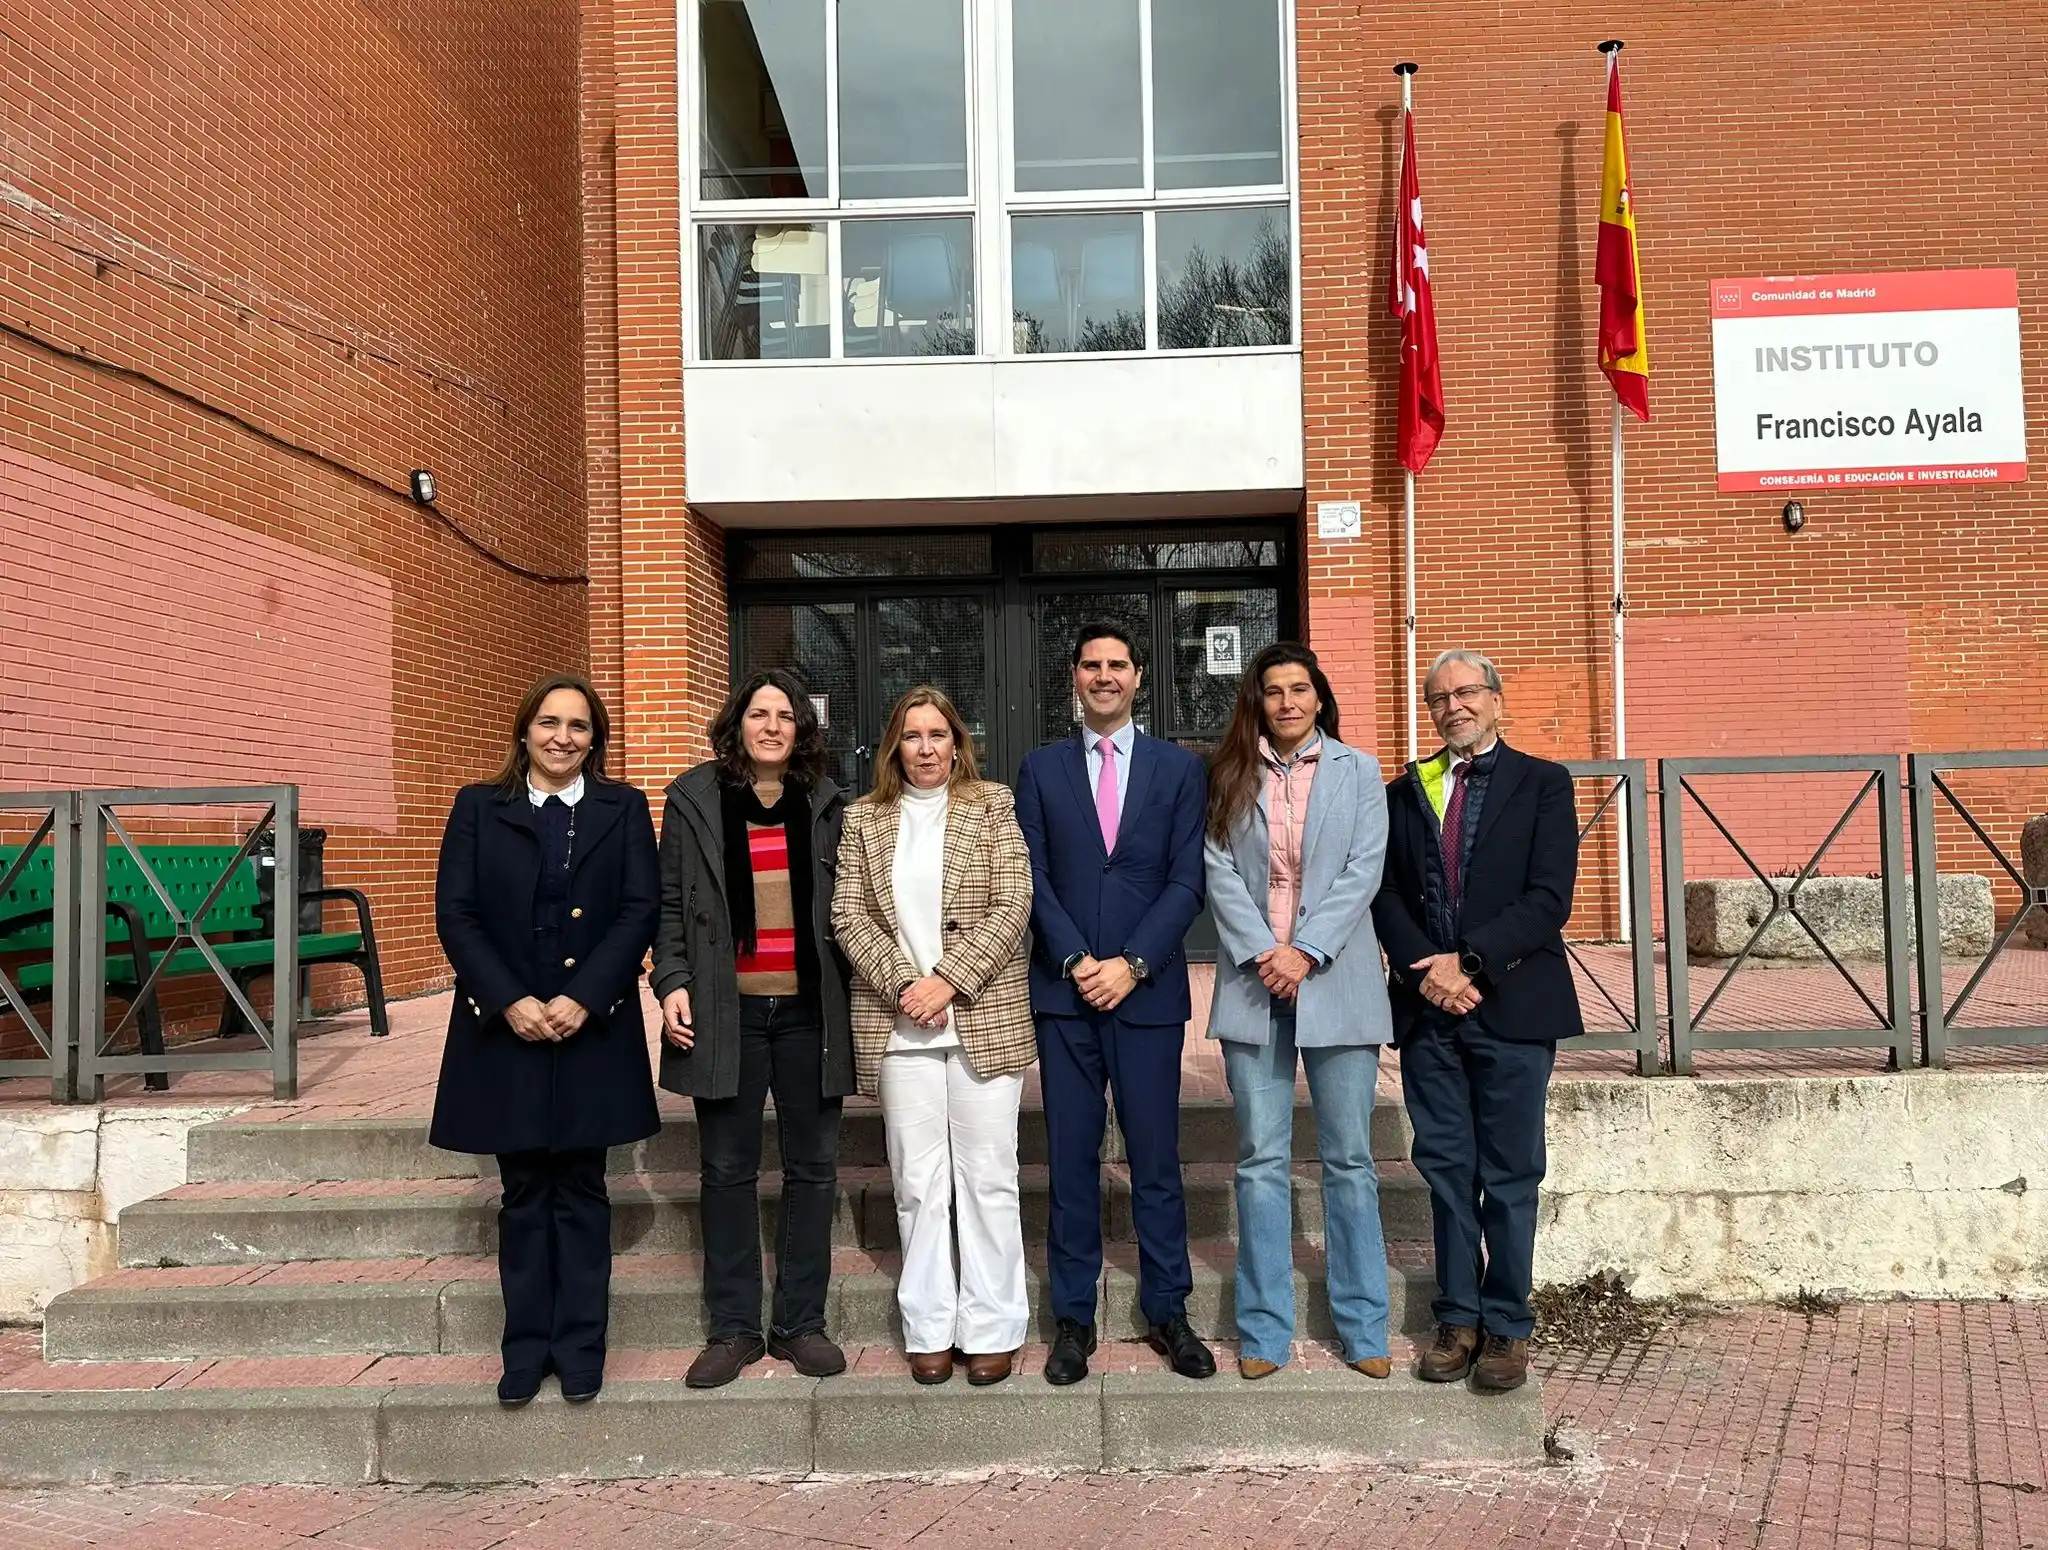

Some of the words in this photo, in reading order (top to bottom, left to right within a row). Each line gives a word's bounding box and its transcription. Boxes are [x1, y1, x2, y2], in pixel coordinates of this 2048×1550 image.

[1752, 290, 1817, 301] Comunidad
[1819, 289, 1834, 299] de
[1836, 287, 1876, 298] Madrid
[1755, 341, 1938, 372] INSTITUTO
[1757, 411, 1895, 439] Francisco
[1904, 407, 1983, 441] Ayala
[1760, 473, 1824, 485] CONSEJERÍA
[1827, 474, 1841, 483] DE
[1844, 470, 1904, 482] EDUCACIÓN
[1908, 472, 1914, 480] E
[1918, 467, 1998, 480] INVESTIGACIÓN
